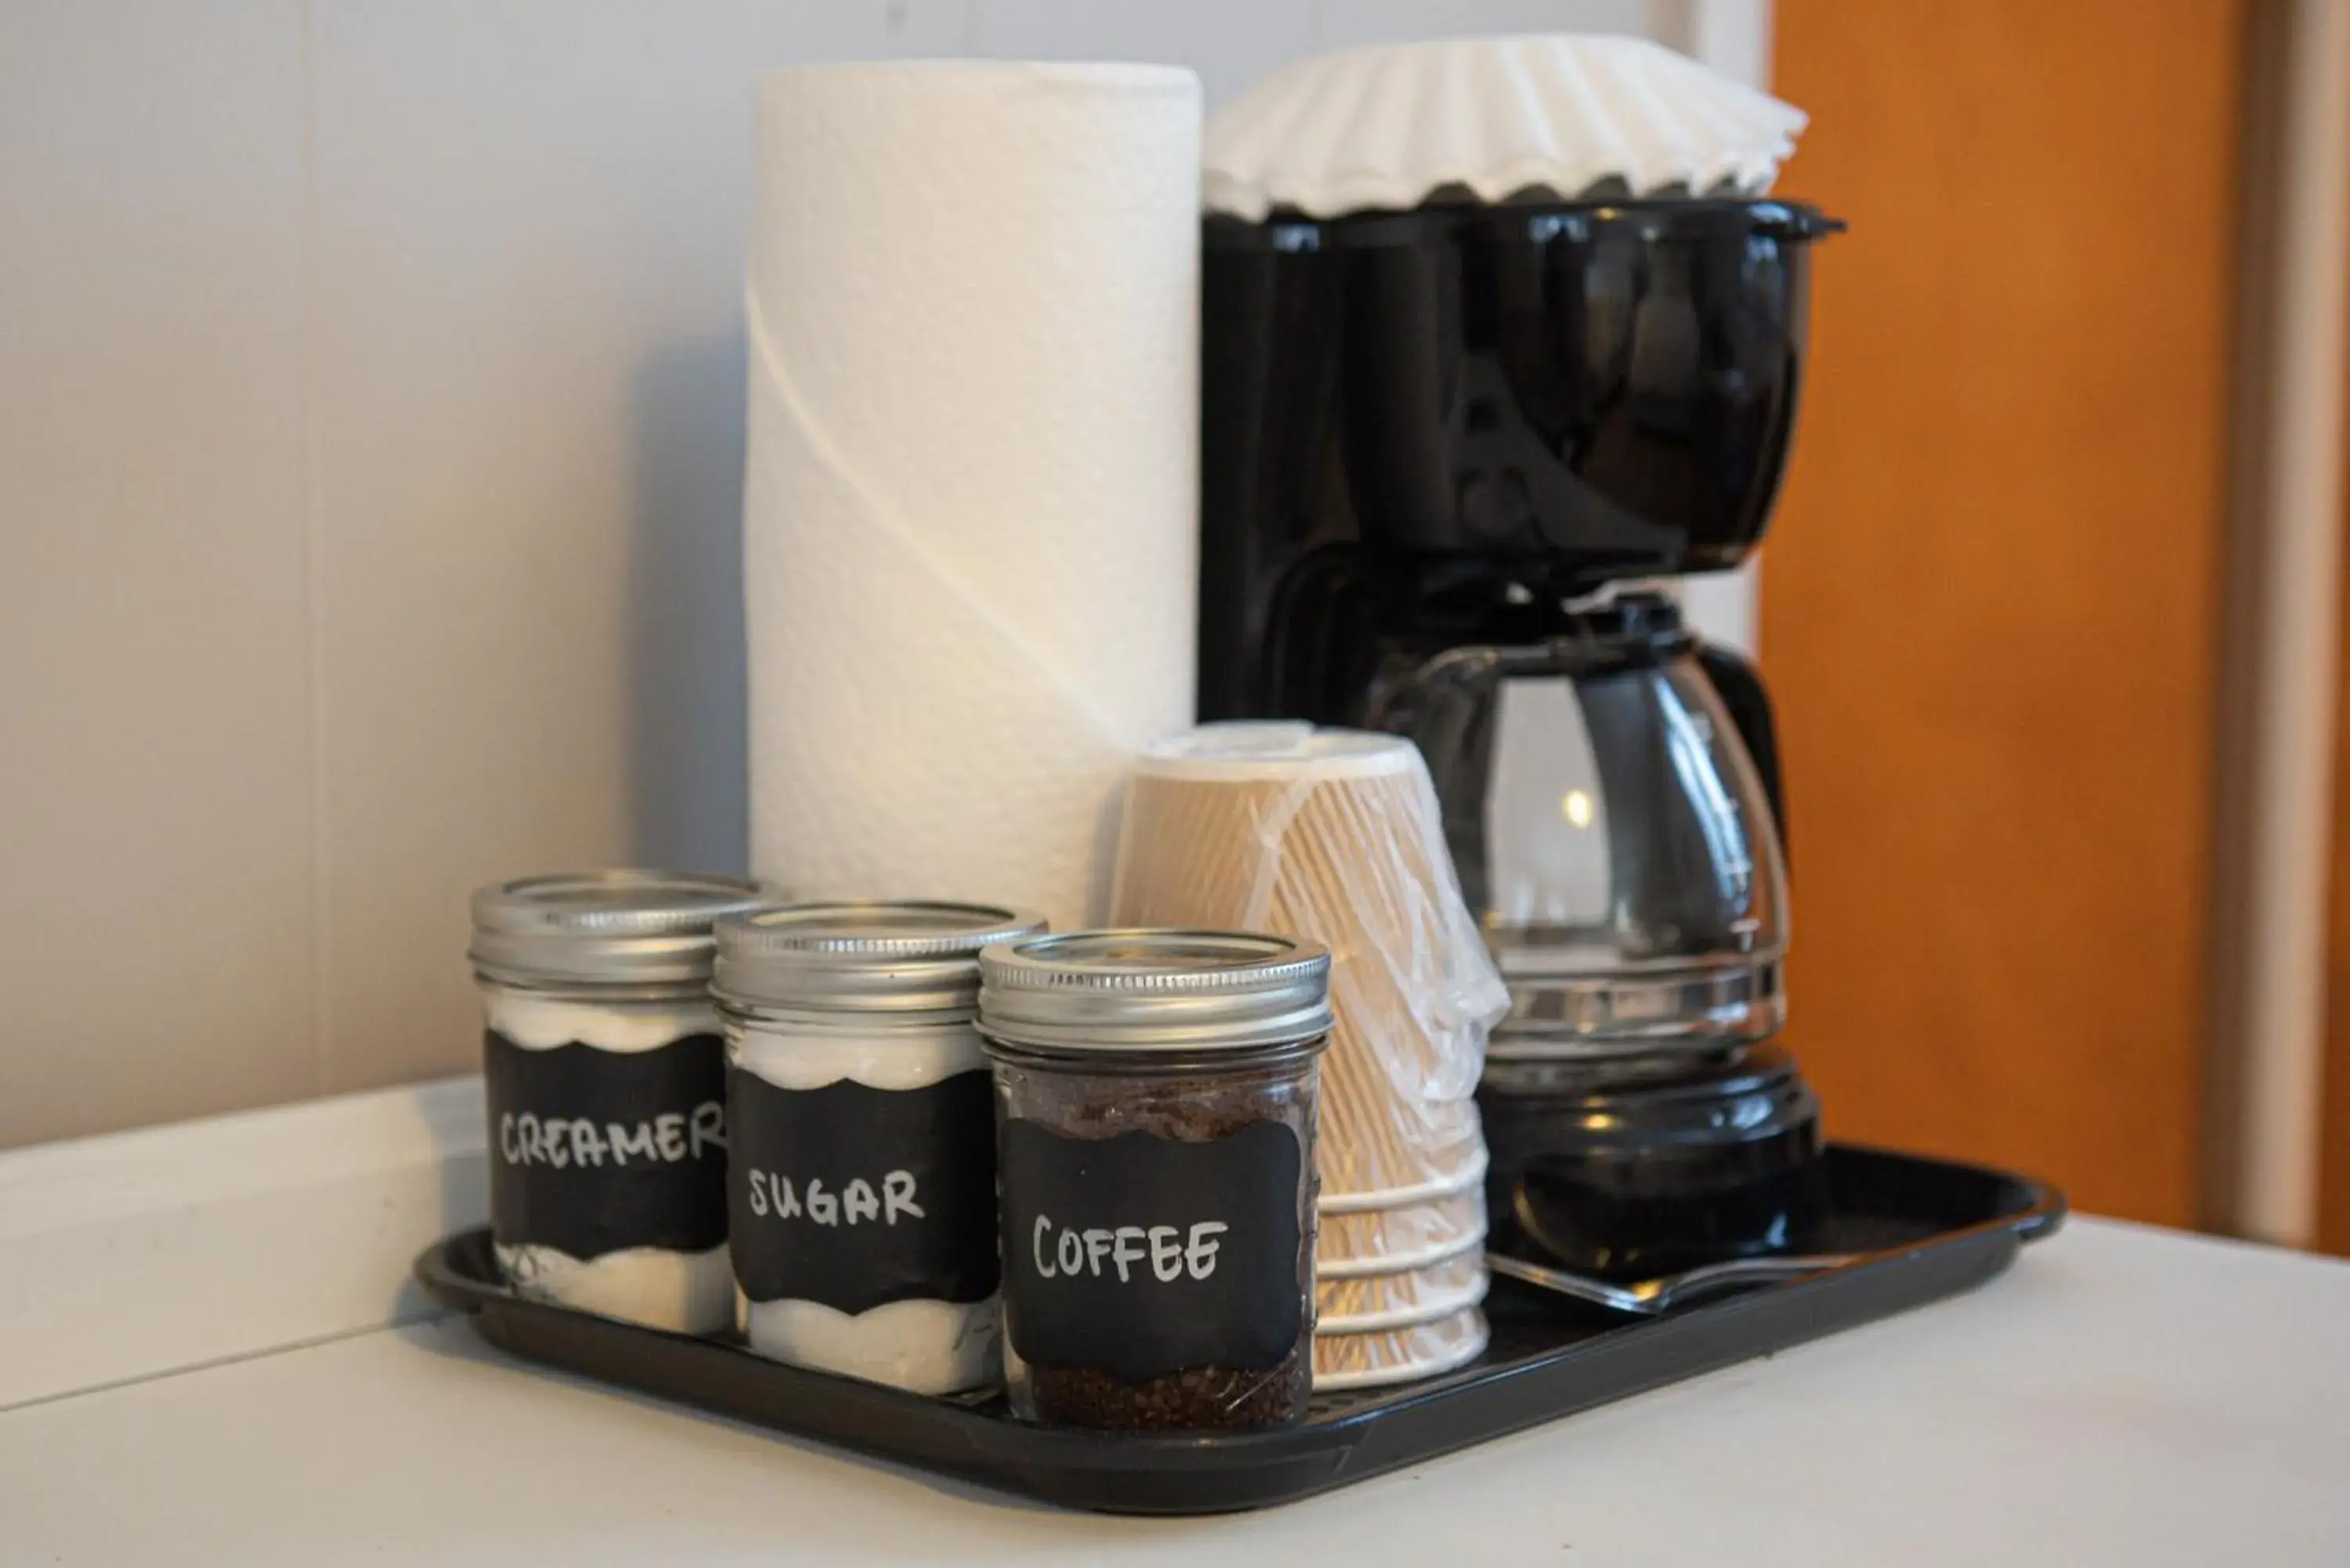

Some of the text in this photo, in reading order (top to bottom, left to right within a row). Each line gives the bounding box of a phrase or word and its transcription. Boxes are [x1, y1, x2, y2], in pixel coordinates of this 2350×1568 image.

[500, 1100, 728, 1167] CREAMER
[750, 1169, 926, 1227] SUGAR
[1033, 1214, 1228, 1283] COFFEE
